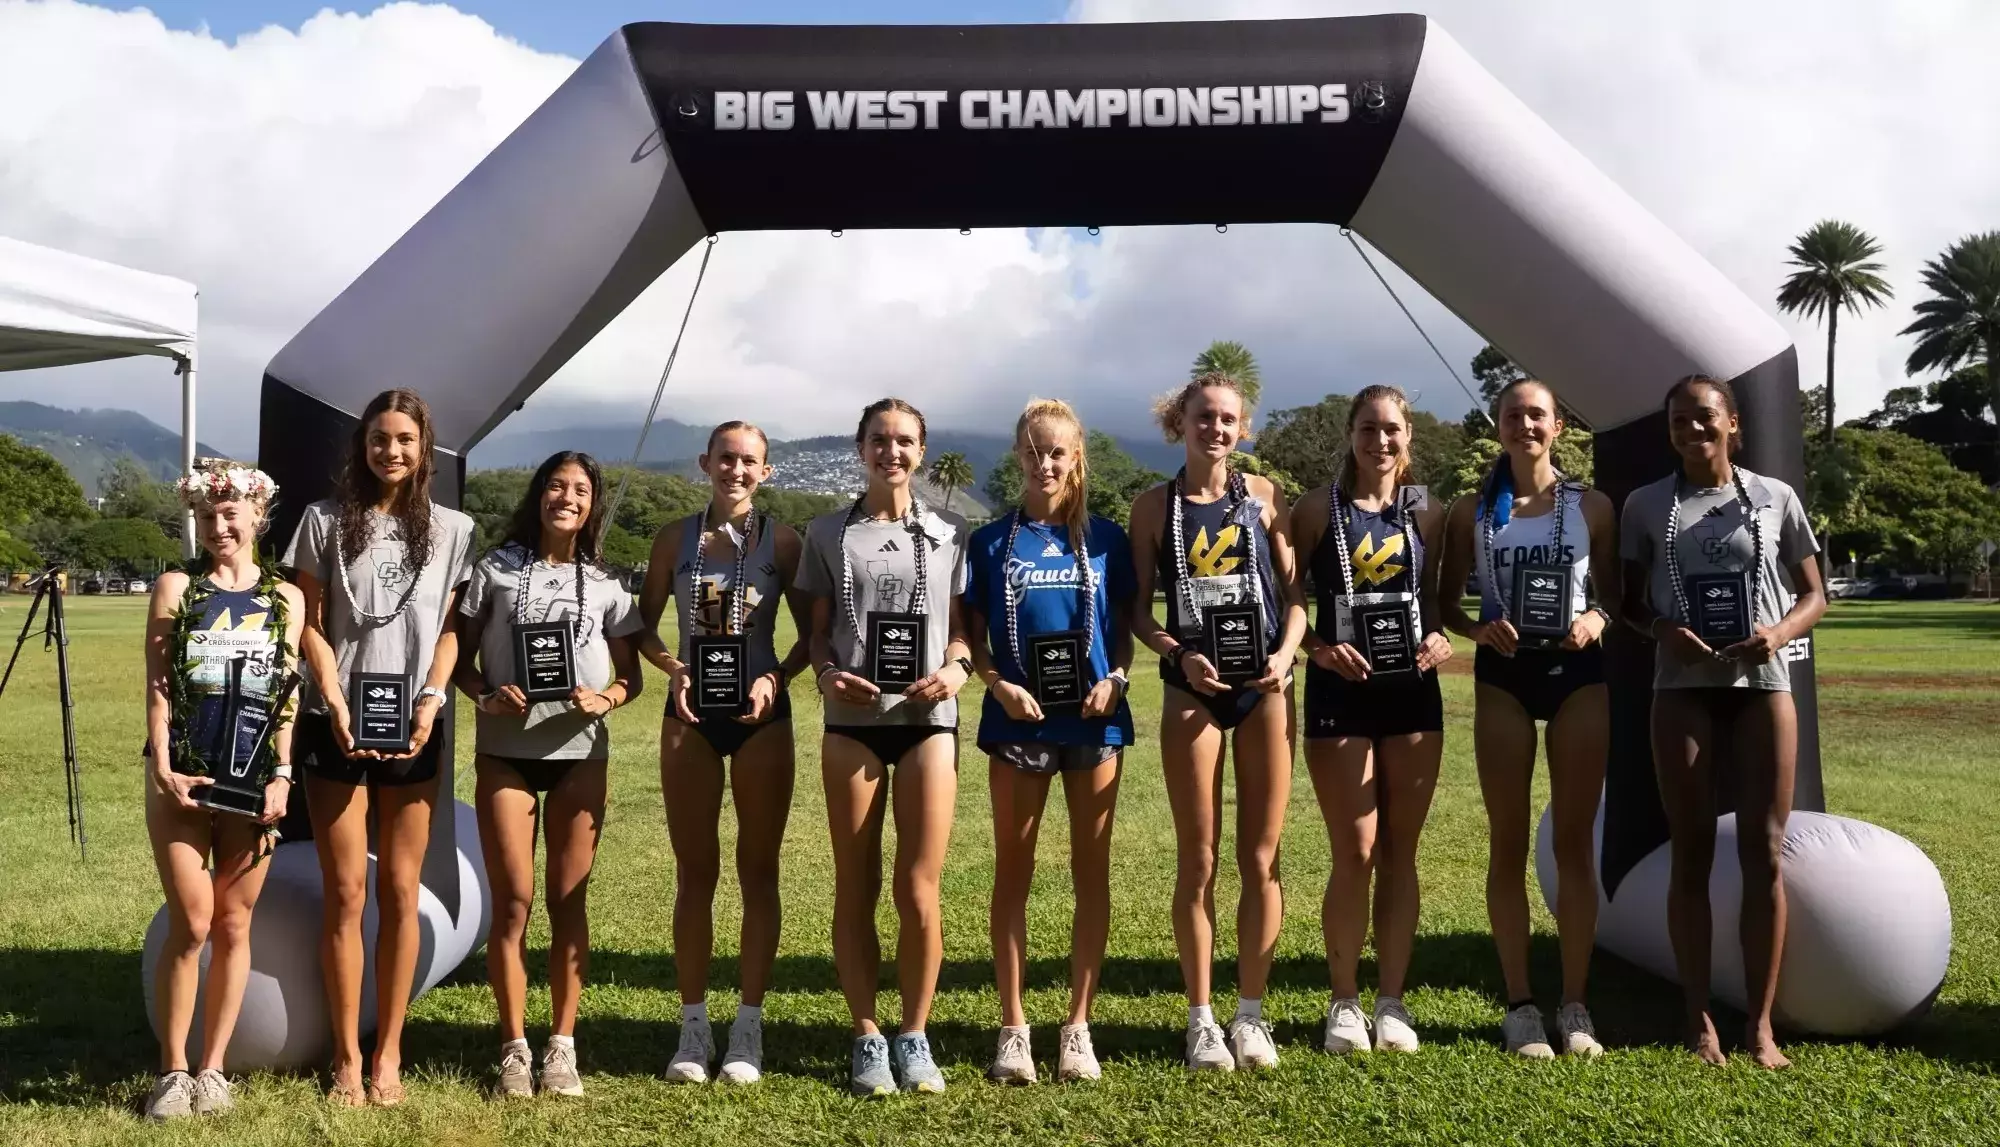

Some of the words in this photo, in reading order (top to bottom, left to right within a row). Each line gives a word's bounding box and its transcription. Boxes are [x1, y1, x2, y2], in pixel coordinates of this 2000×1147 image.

[714, 91, 795, 131] BIG
[806, 90, 948, 130] WEST
[959, 83, 1350, 129] CHAMPIONSHIPS
[1787, 637, 1810, 662] EST
[240, 710, 268, 721] CHAMPION
